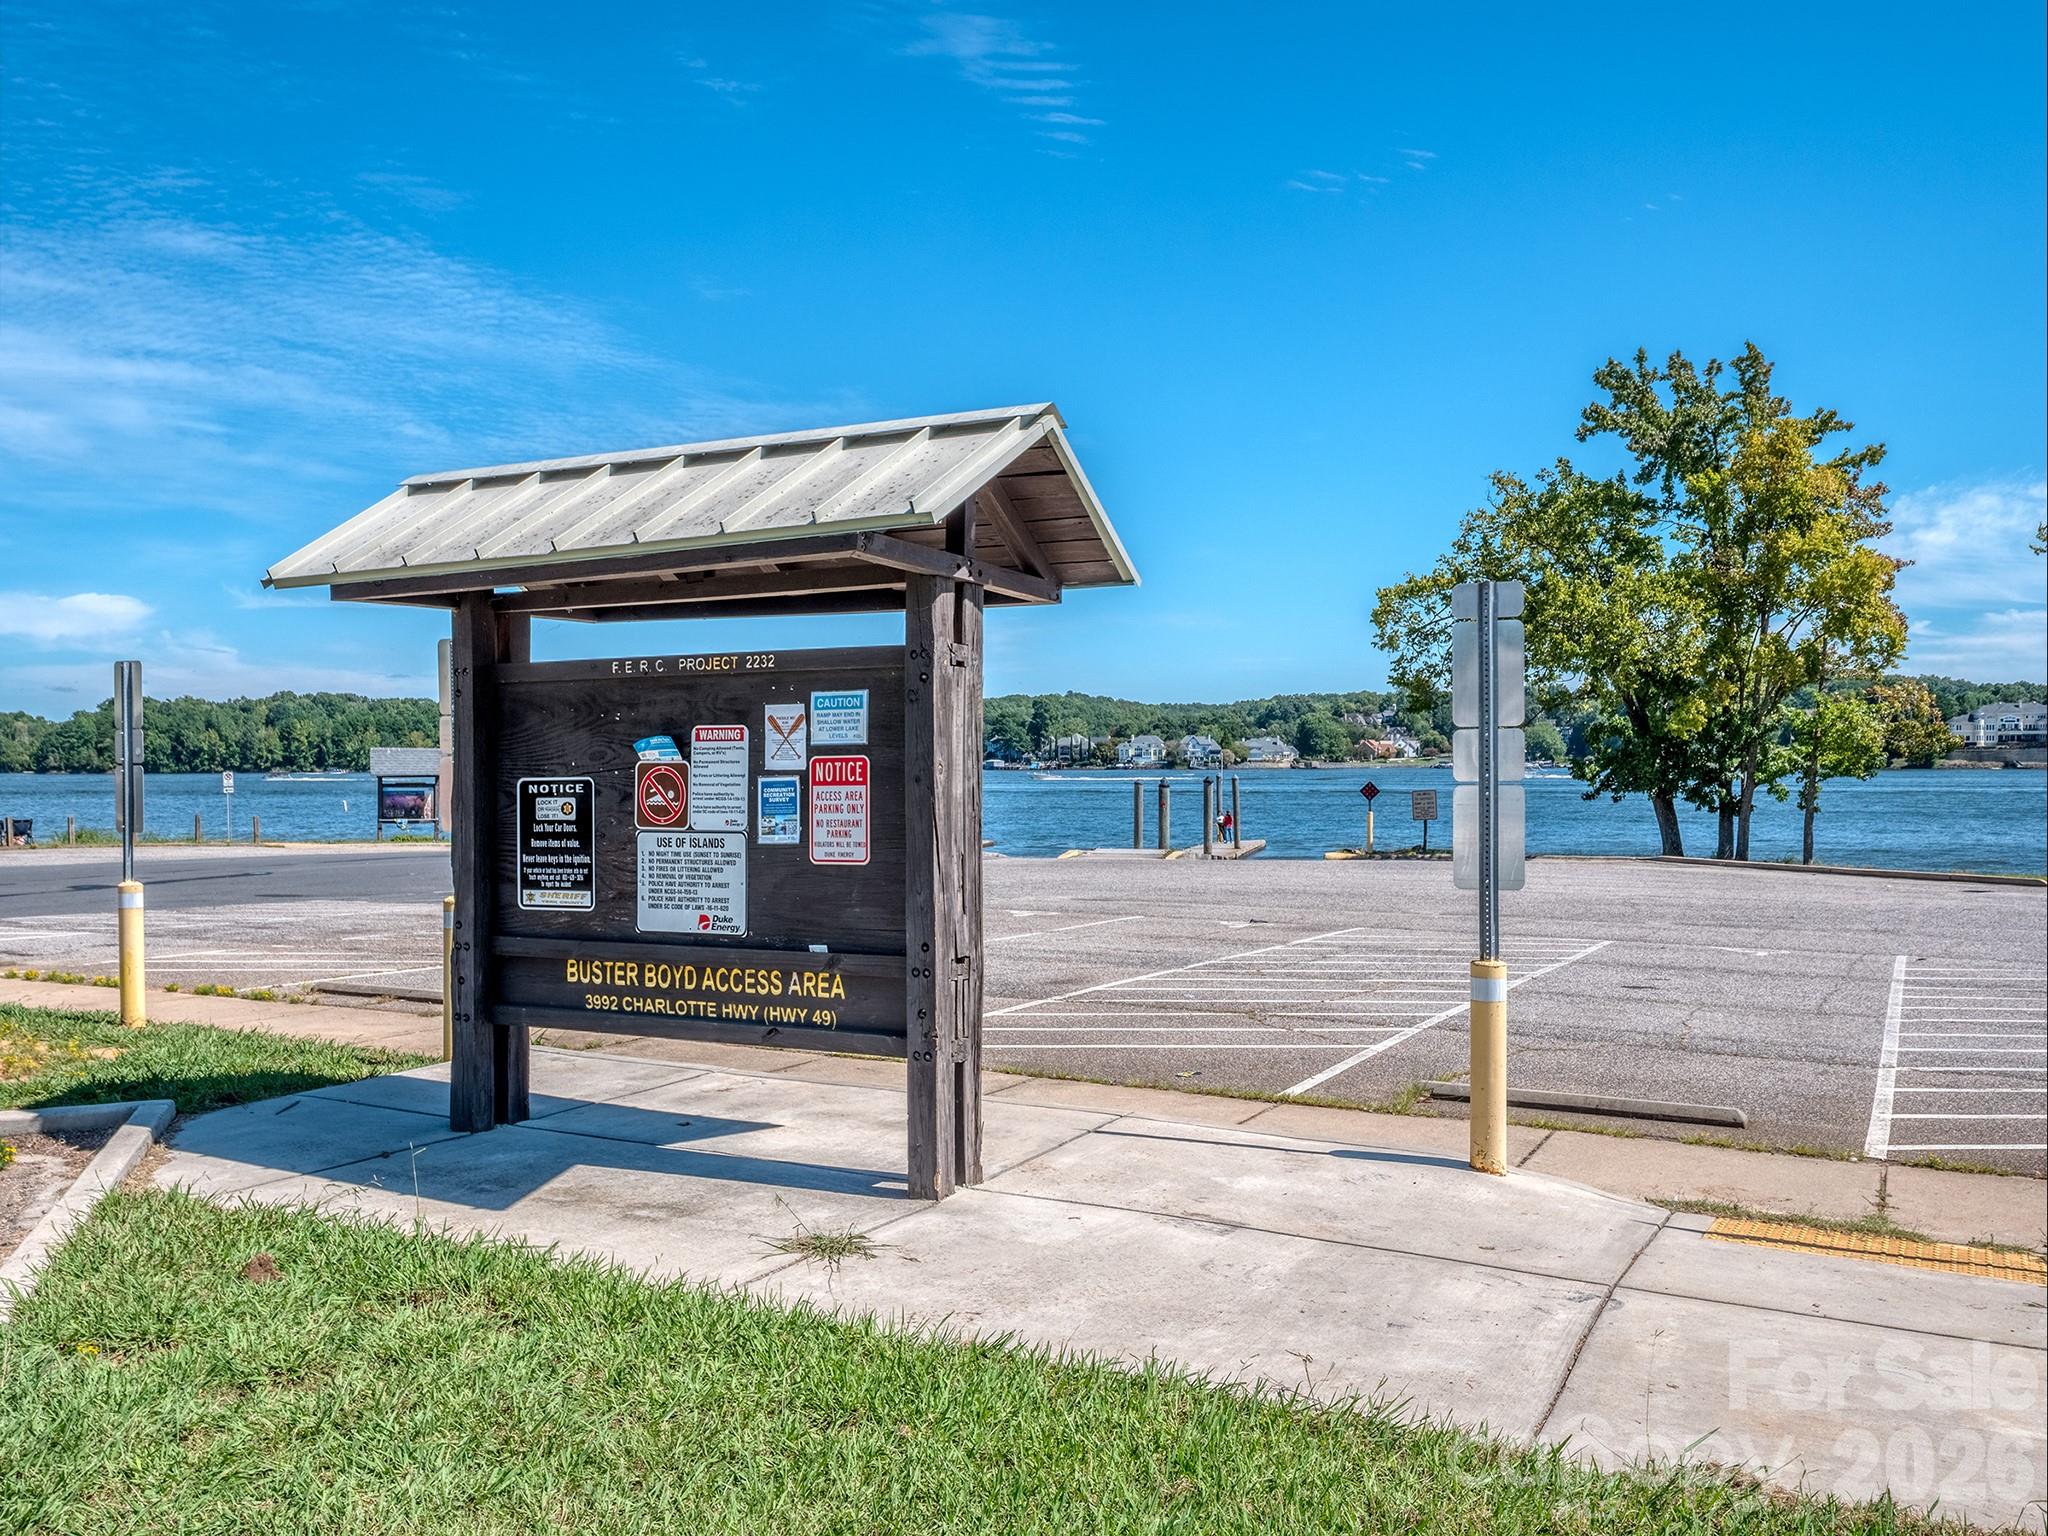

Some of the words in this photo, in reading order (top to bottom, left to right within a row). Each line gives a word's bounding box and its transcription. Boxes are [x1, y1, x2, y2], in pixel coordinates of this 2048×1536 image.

[679, 656, 738, 670] PROJECT
[746, 655, 775, 668] 2232
[817, 698, 860, 708] CAUTION
[699, 729, 741, 740] WARNING
[816, 761, 863, 782] NOTICE
[528, 784, 584, 794] NOTICE
[816, 791, 842, 801] ACCESS
[844, 791, 863, 801] AREA
[814, 804, 843, 814] PARKING
[847, 804, 864, 814] ONLY
[533, 823, 543, 832] Lock
[544, 823, 554, 832] Your
[563, 823, 577, 832] Doors.
[816, 819, 824, 828] NO
[826, 819, 862, 828] RESTAURANT
[827, 830, 852, 838] PARKING
[531, 838, 547, 848] Remove
[548, 839, 560, 848] items
[561, 838, 566, 848] of
[567, 838, 580, 848] value.
[657, 837, 672, 848] USE
[676, 837, 686, 848] OF
[689, 838, 725, 849] ISLANDS
[522, 854, 535, 863] Never
[536, 854, 547, 863] leave
[548, 854, 558, 865] keys
[559, 854, 564, 863] in
[564, 854, 572, 863] the
[540, 892, 588, 900] SHERIFF
[712, 915, 733, 923] Duke
[711, 923, 740, 933] Energy
[567, 959, 639, 986] BUSTER
[644, 964, 697, 990] BOYD
[702, 968, 782, 996] ACCESS
[788, 972, 845, 1000] AREA
[585, 994, 618, 1010] 3992
[622, 996, 717, 1018] CHARLOTTE
[722, 1004, 759, 1021] HWY
[764, 1006, 807, 1025] (HWY
[812, 1010, 837, 1030] 49)
